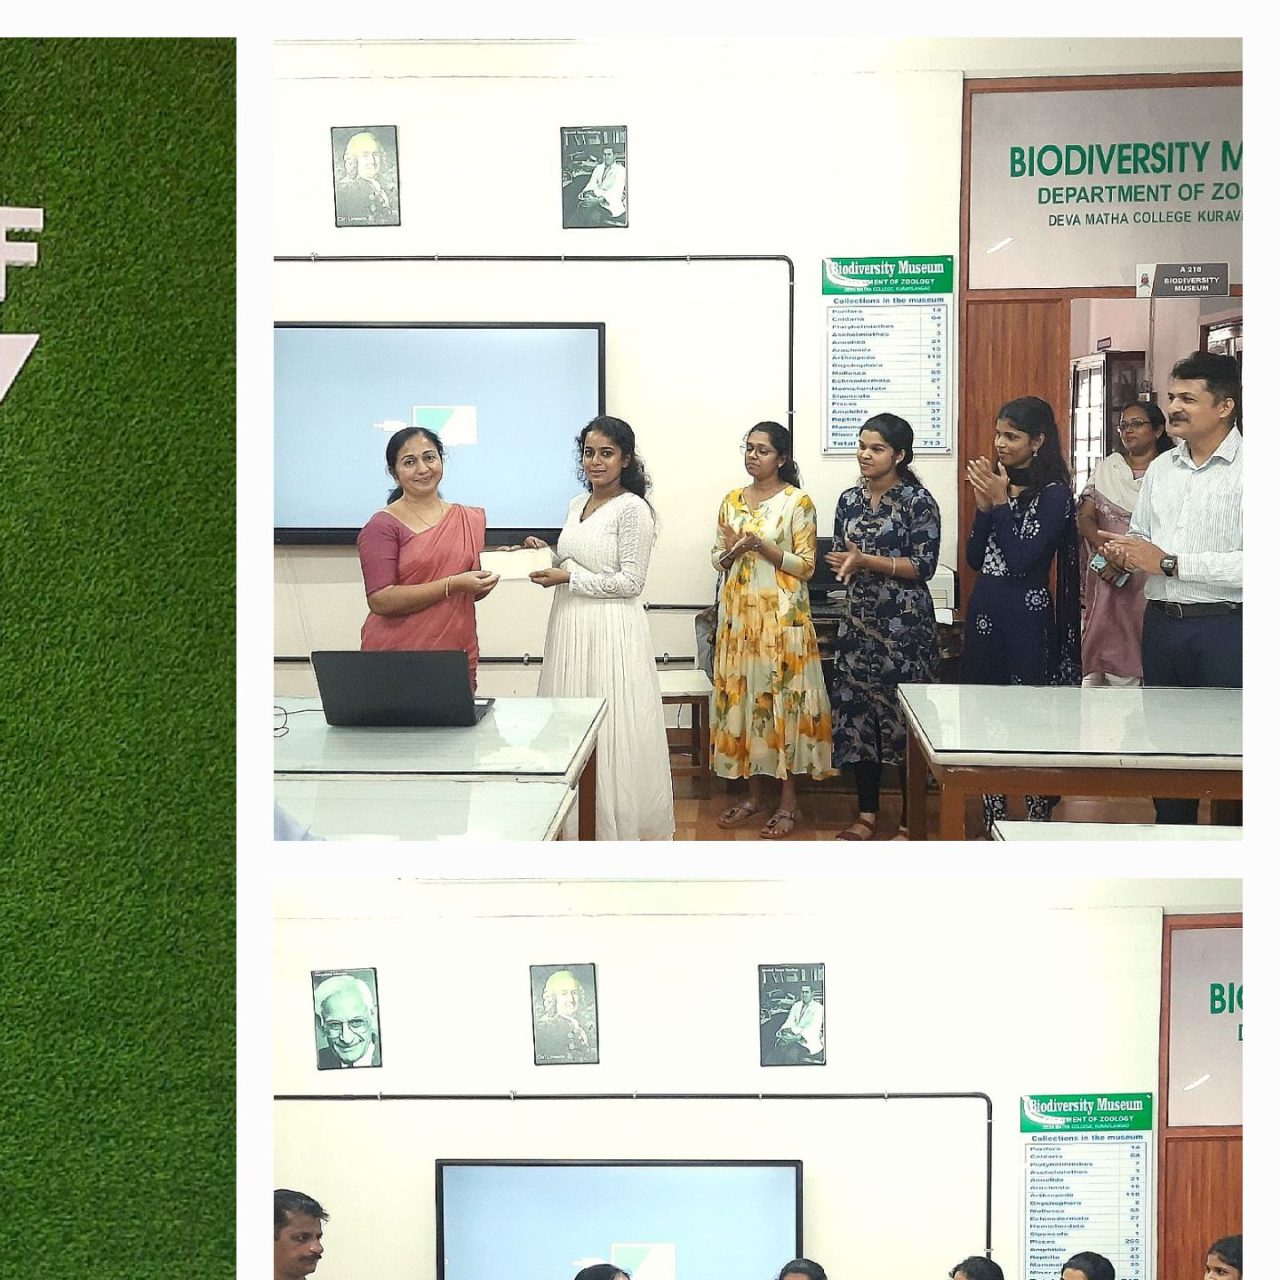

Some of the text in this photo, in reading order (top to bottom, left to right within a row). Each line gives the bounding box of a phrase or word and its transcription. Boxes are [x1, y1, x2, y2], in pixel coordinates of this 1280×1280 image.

[1009, 141, 1211, 178] BIODIVERSITY
[1037, 183, 1172, 205] DEPARTMENT
[1177, 182, 1205, 202] OF
[1048, 213, 1081, 227] DEVA
[1085, 212, 1129, 226] MATHA
[1133, 210, 1192, 224] COLLEGE
[831, 260, 945, 278] Biodiversity Museum
[1164, 276, 1220, 285] BIODIVERSITY
[833, 297, 880, 305] Collections
[1030, 1097, 1143, 1115] Biodiversity Museum
